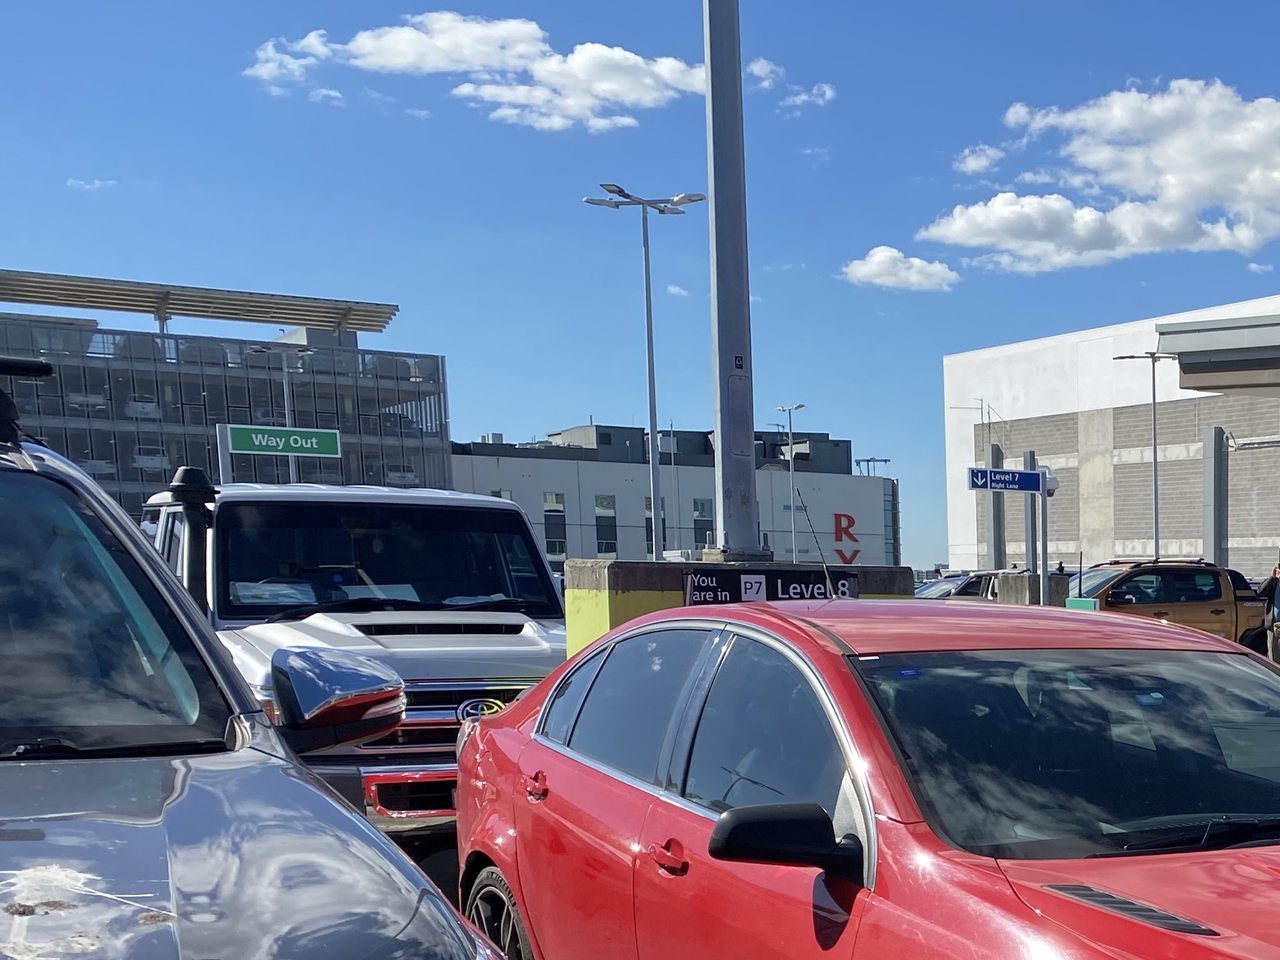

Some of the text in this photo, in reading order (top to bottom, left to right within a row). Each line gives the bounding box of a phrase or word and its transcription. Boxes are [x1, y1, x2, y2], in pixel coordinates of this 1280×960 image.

[251, 433, 318, 449] Way Out
[992, 472, 1019, 482] Level 7
[691, 573, 717, 587] You
[692, 588, 730, 602] are in
[743, 581, 763, 595] P7
[777, 578, 850, 599] Level 8
